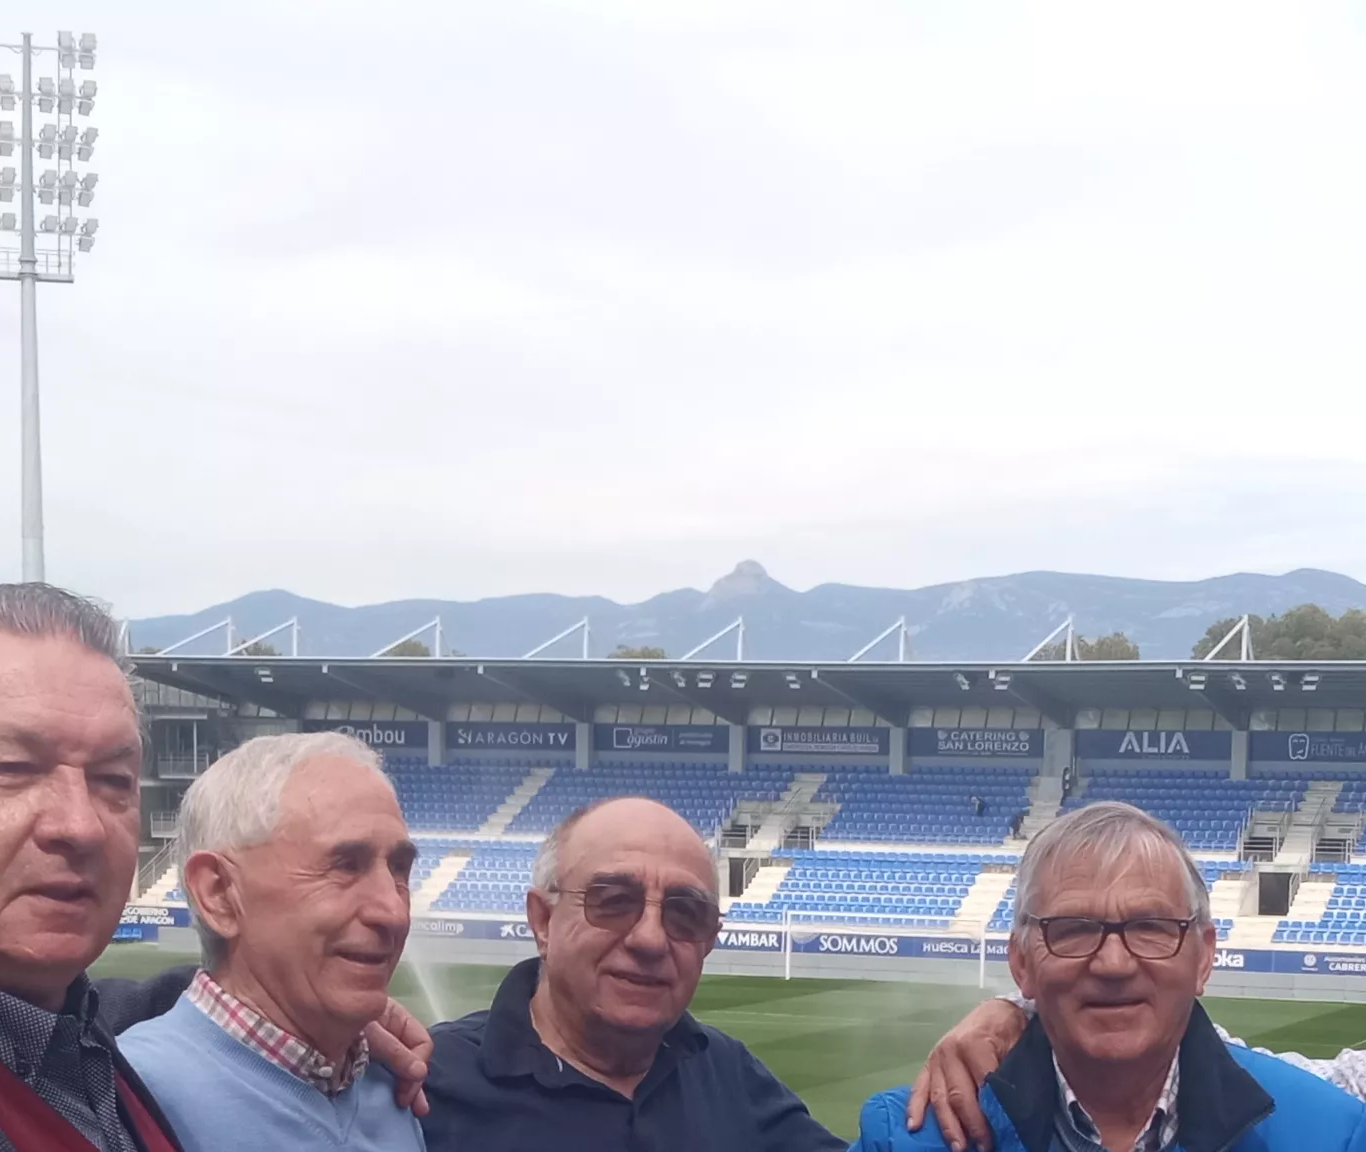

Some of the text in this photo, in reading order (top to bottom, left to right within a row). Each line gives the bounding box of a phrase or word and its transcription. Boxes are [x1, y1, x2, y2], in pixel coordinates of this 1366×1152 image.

[336, 719, 405, 744] mbou
[783, 732, 847, 742] INMOBILIARIA
[850, 733, 871, 743] BUIL
[950, 731, 1016, 741] CATERING
[548, 733, 568, 745] TV
[1118, 731, 1190, 753] ALIA
[938, 742, 1030, 751] SAN LORENZO
[728, 932, 779, 947] AMBAR
[819, 935, 898, 954] SOMMOS
